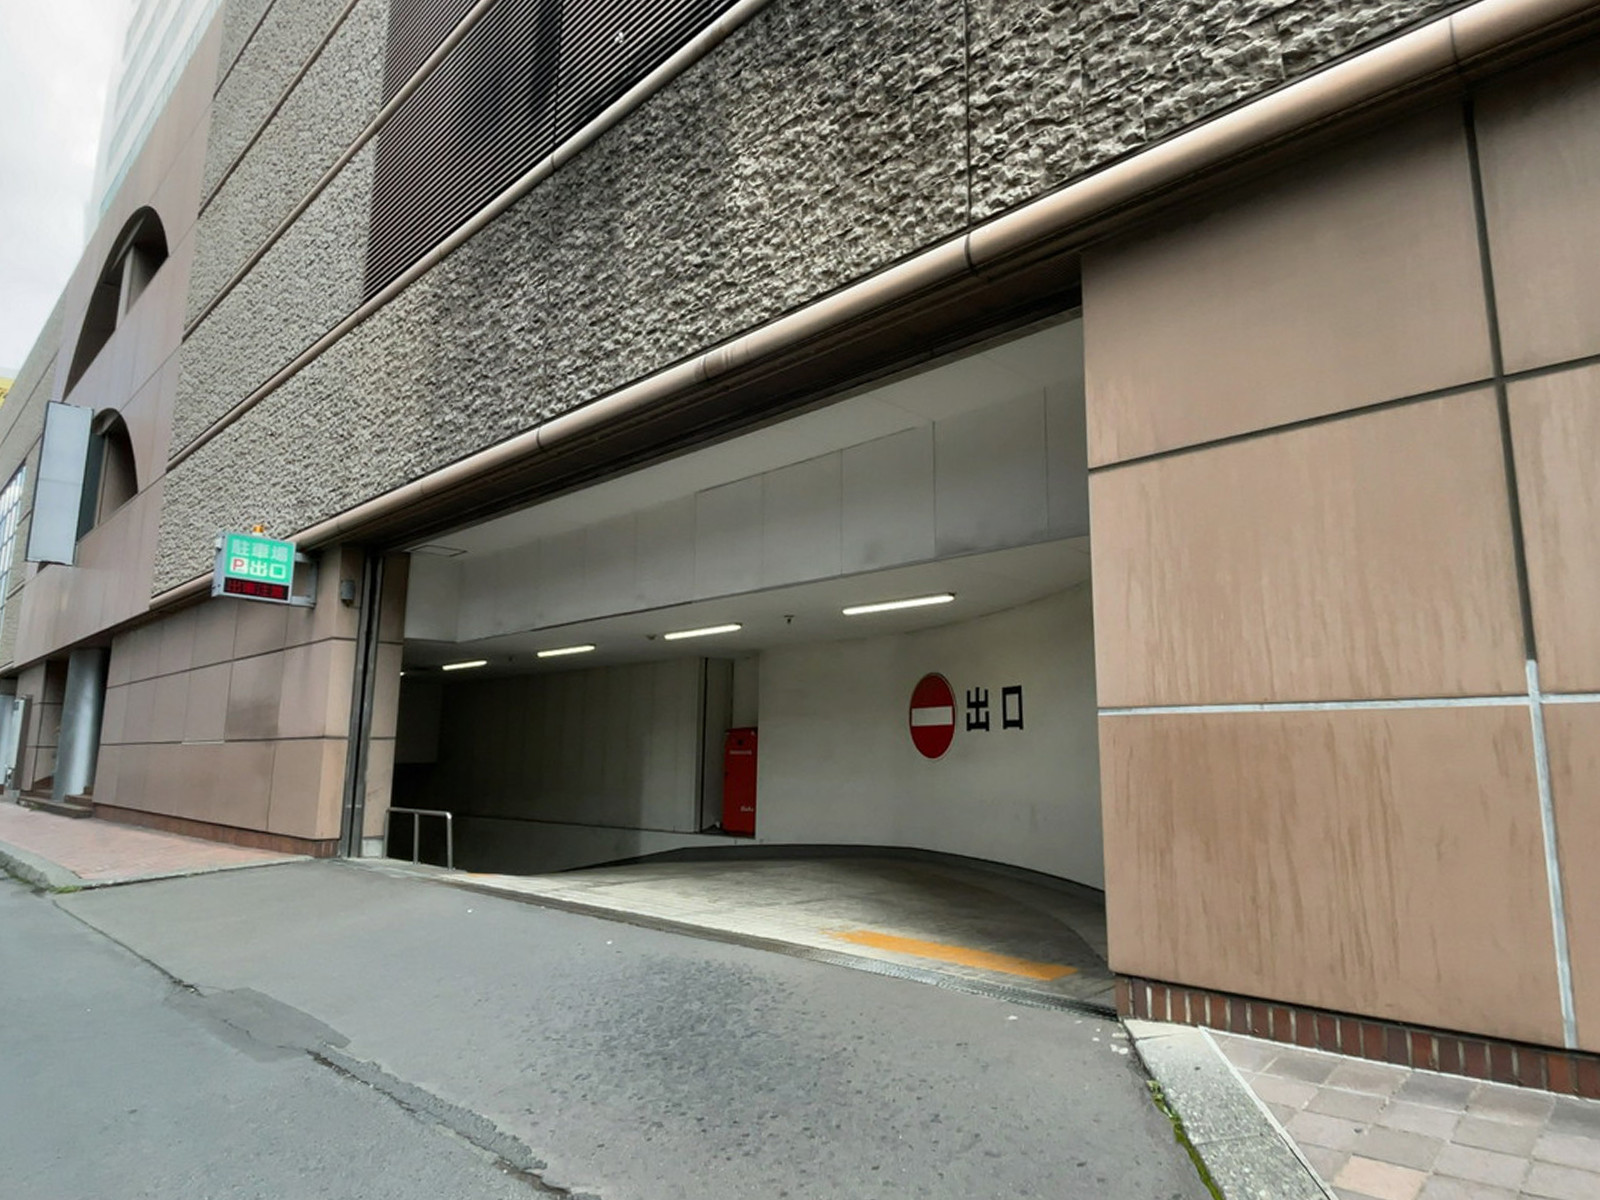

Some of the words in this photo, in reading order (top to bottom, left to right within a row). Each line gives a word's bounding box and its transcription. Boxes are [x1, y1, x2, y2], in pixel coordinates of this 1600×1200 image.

[232, 558, 245, 571] P
[249, 560, 287, 579] 出口
[966, 685, 1024, 732] 出口
